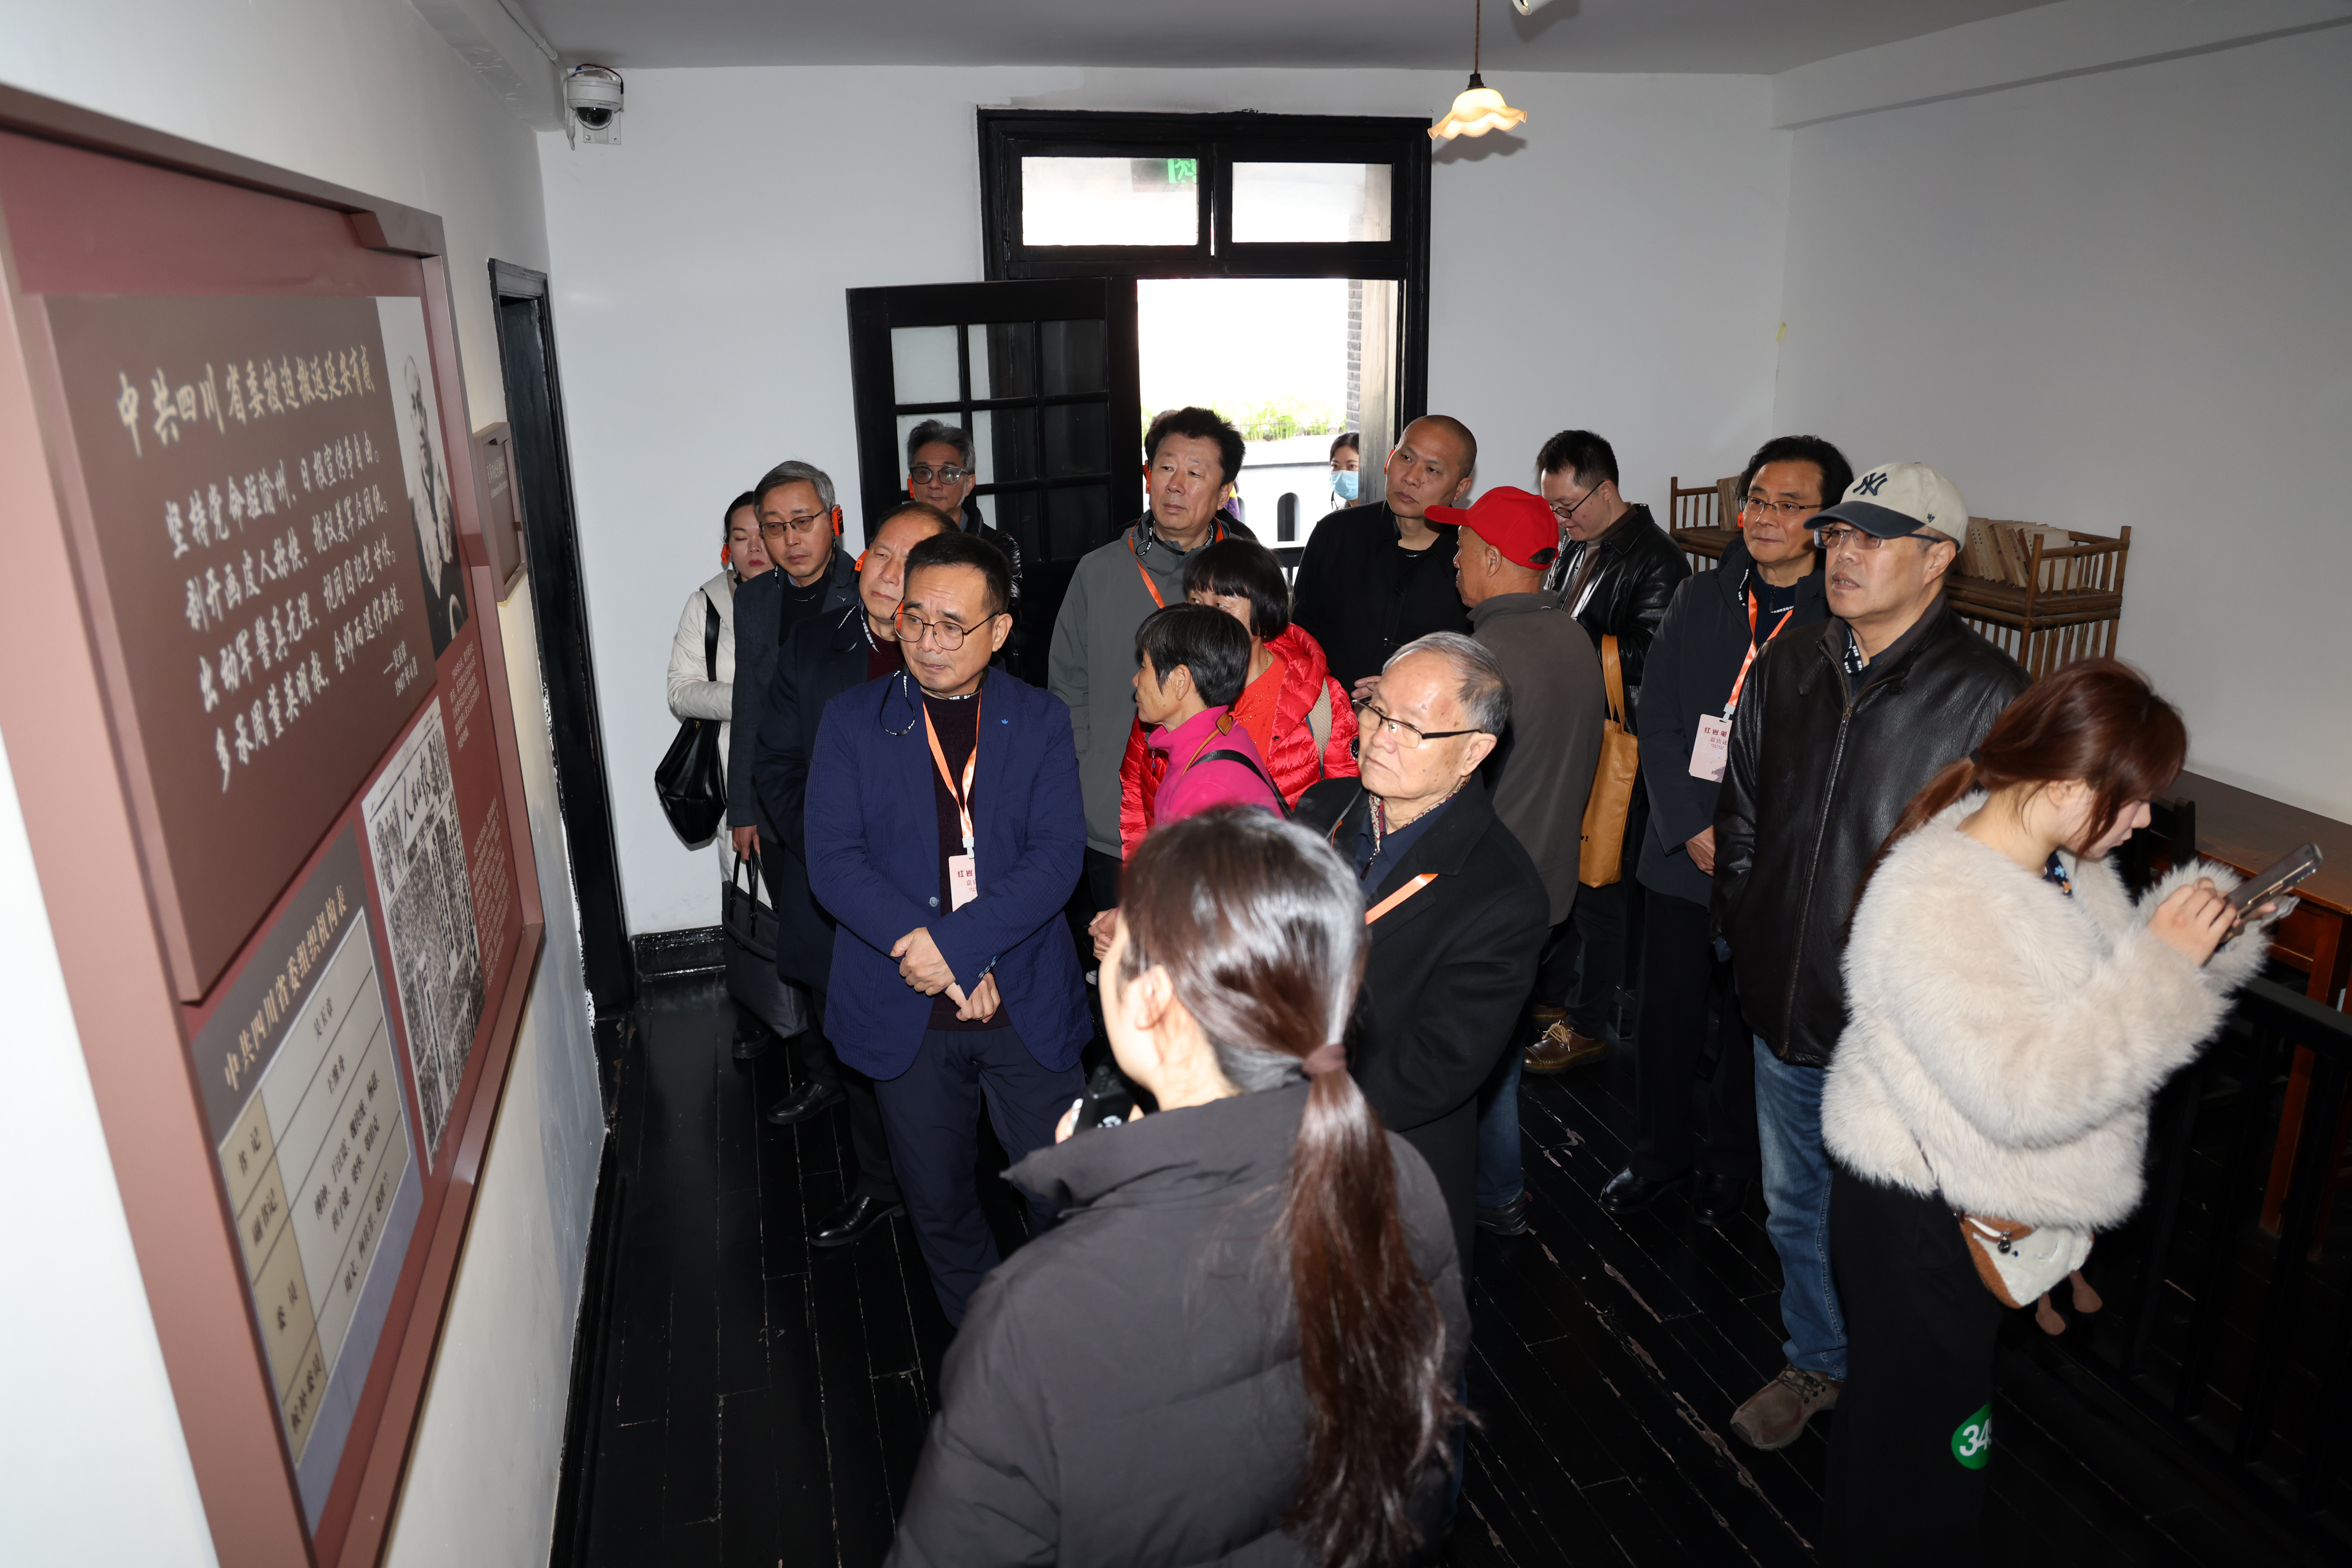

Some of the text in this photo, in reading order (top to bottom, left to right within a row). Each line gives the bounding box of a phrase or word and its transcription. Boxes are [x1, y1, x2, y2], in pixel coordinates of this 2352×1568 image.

[117, 345, 375, 458] 中共四川省委被迫撤返延安有感
[1853, 473, 1887, 496] NY
[395, 657, 418, 697] 1947年4月
[225, 885, 347, 1092] 中共四川省委组织机构表
[313, 997, 333, 1041] 吴玉章
[252, 1187, 278, 1246] 副书记
[1959, 1415, 1992, 1456] 34
